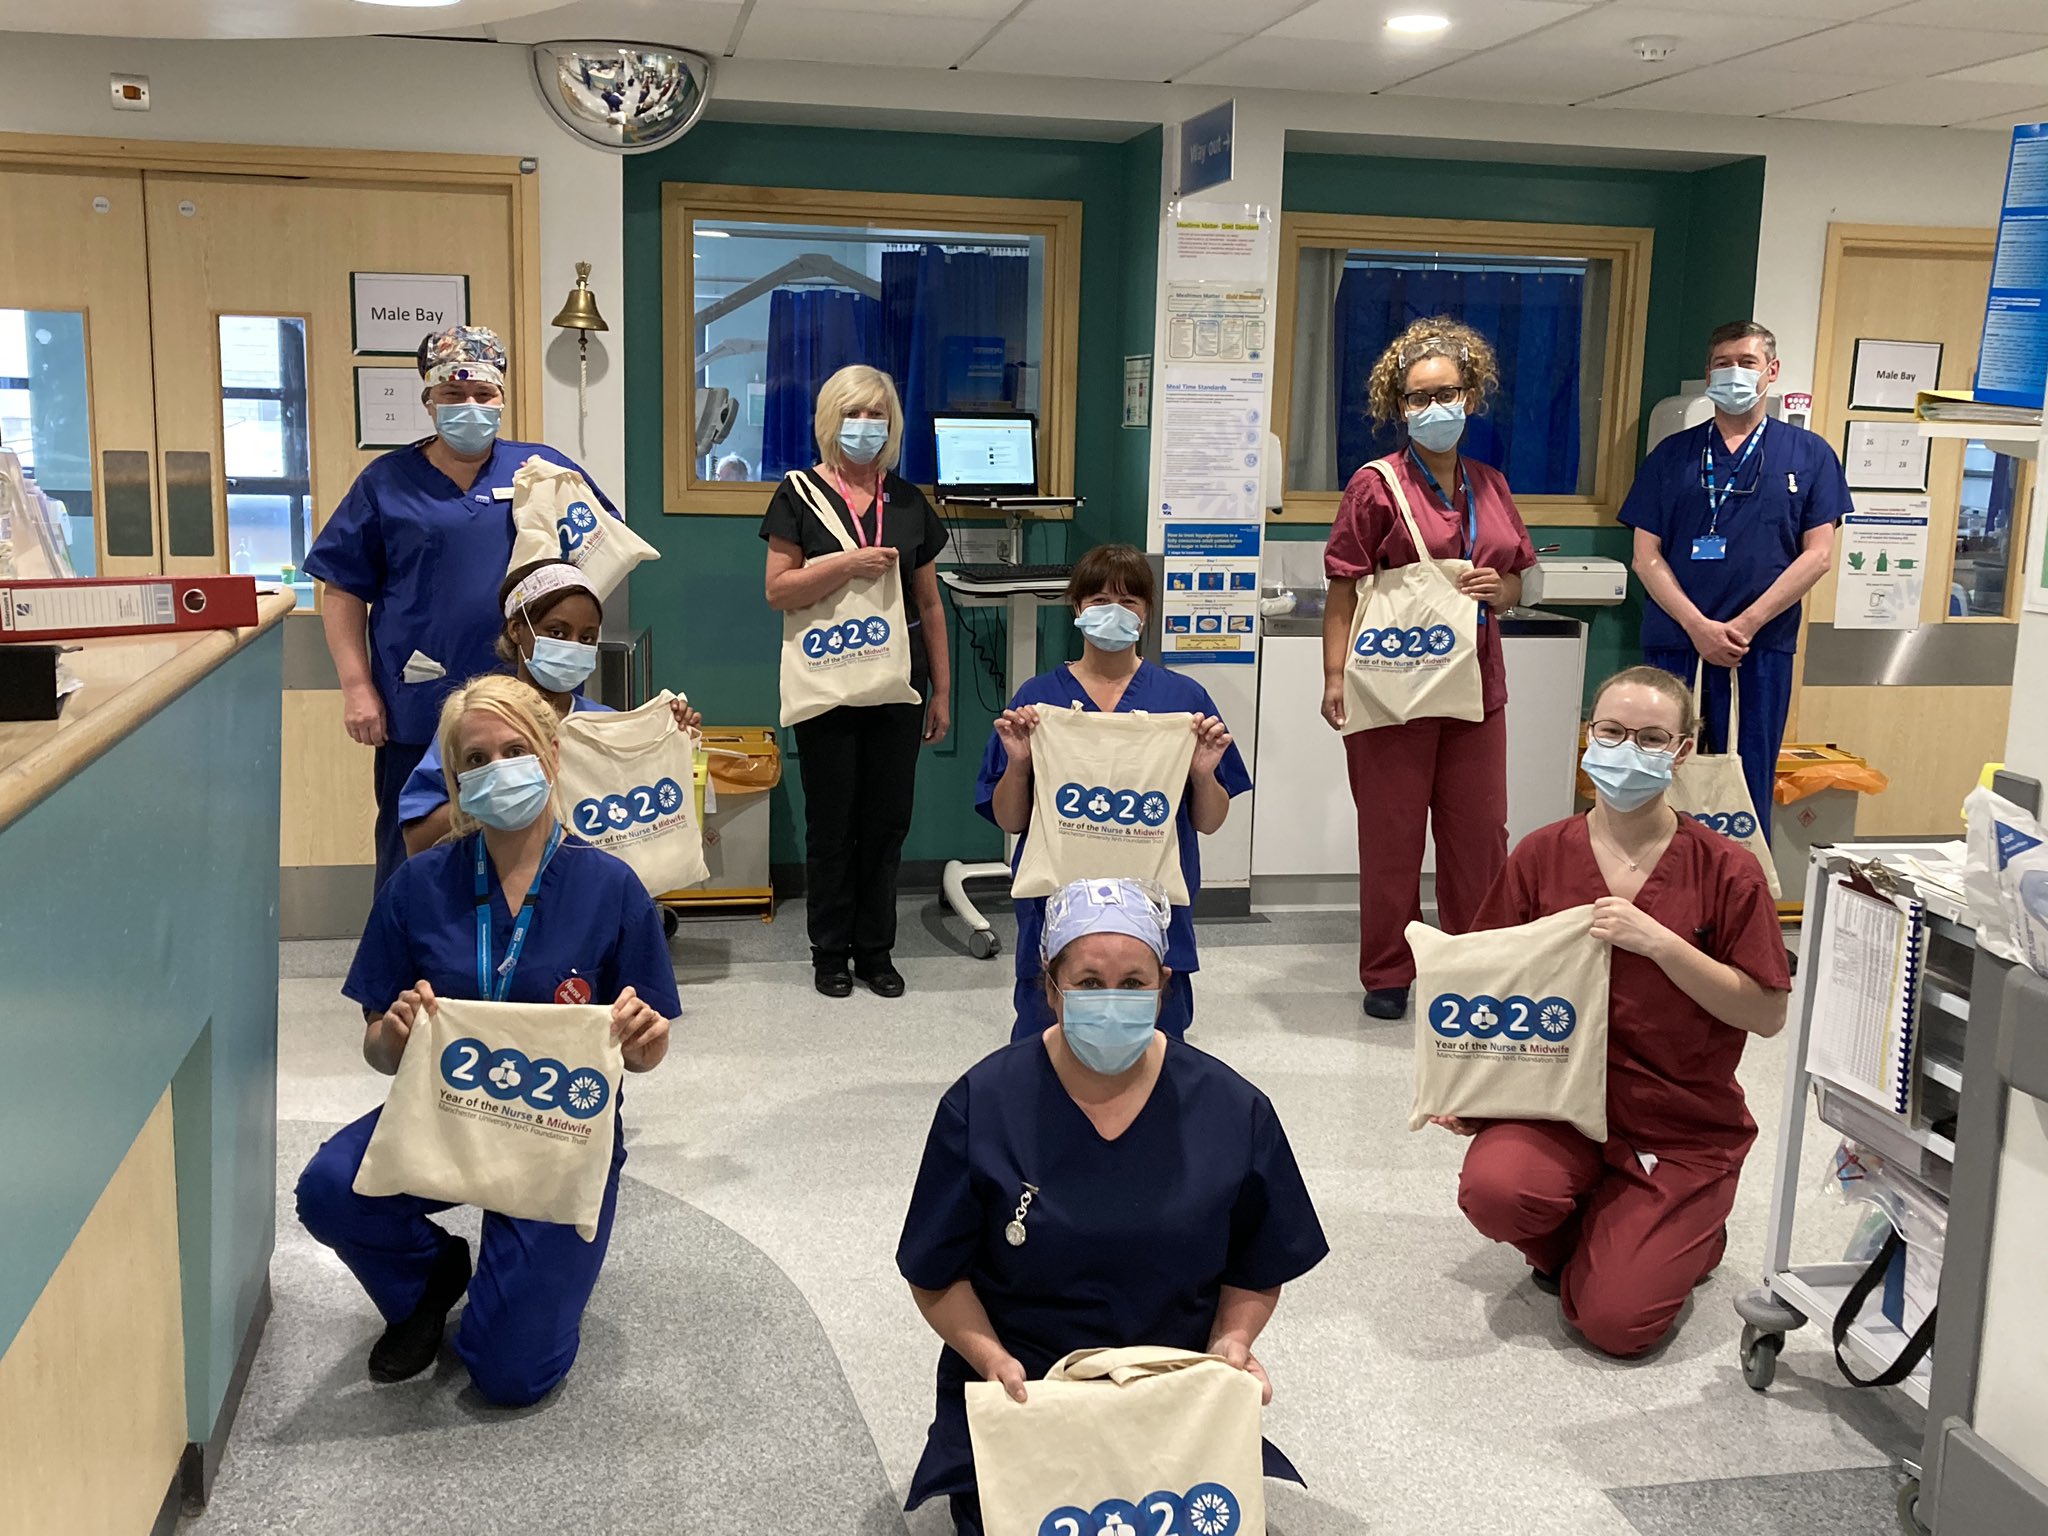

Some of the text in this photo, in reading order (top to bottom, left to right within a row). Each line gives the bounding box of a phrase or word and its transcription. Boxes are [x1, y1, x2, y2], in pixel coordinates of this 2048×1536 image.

[1190, 136, 1221, 165] Way out
[371, 307, 444, 325] Male Bay
[1876, 370, 1917, 383] Male Bay
[384, 387, 395, 397] 22
[385, 412, 396, 422] 21
[1866, 438, 1874, 446] 26
[1863, 459, 1872, 468] 25
[808, 658, 823, 667] Year
[830, 655, 841, 663] the
[863, 647, 890, 657] Midwife
[1354, 657, 1371, 666] Year
[1371, 658, 1379, 666] of
[1393, 660, 1414, 668] Nurse
[1422, 657, 1451, 667] Midwife
[603, 835, 614, 845] of
[615, 833, 627, 843] the
[628, 827, 651, 840] Nurse
[652, 824, 658, 833] &
[658, 815, 686, 832] Midwife
[1058, 819, 1075, 829] Year
[1076, 821, 1086, 831] of
[1086, 823, 1100, 832] the
[1101, 826, 1124, 835] Nurse
[1133, 828, 1165, 837] Midwife
[1435, 1040, 1569, 1054] Year of the Nurse & Midwife
[1436, 1052, 1473, 1060] Manchester
[1473, 1053, 1502, 1062] University
[1517, 1055, 1553, 1064] Foundation
[439, 1088, 592, 1137] Year of the Nurse & Midwife
[438, 1102, 588, 1147] Manchester University NHS Foundation Trust
